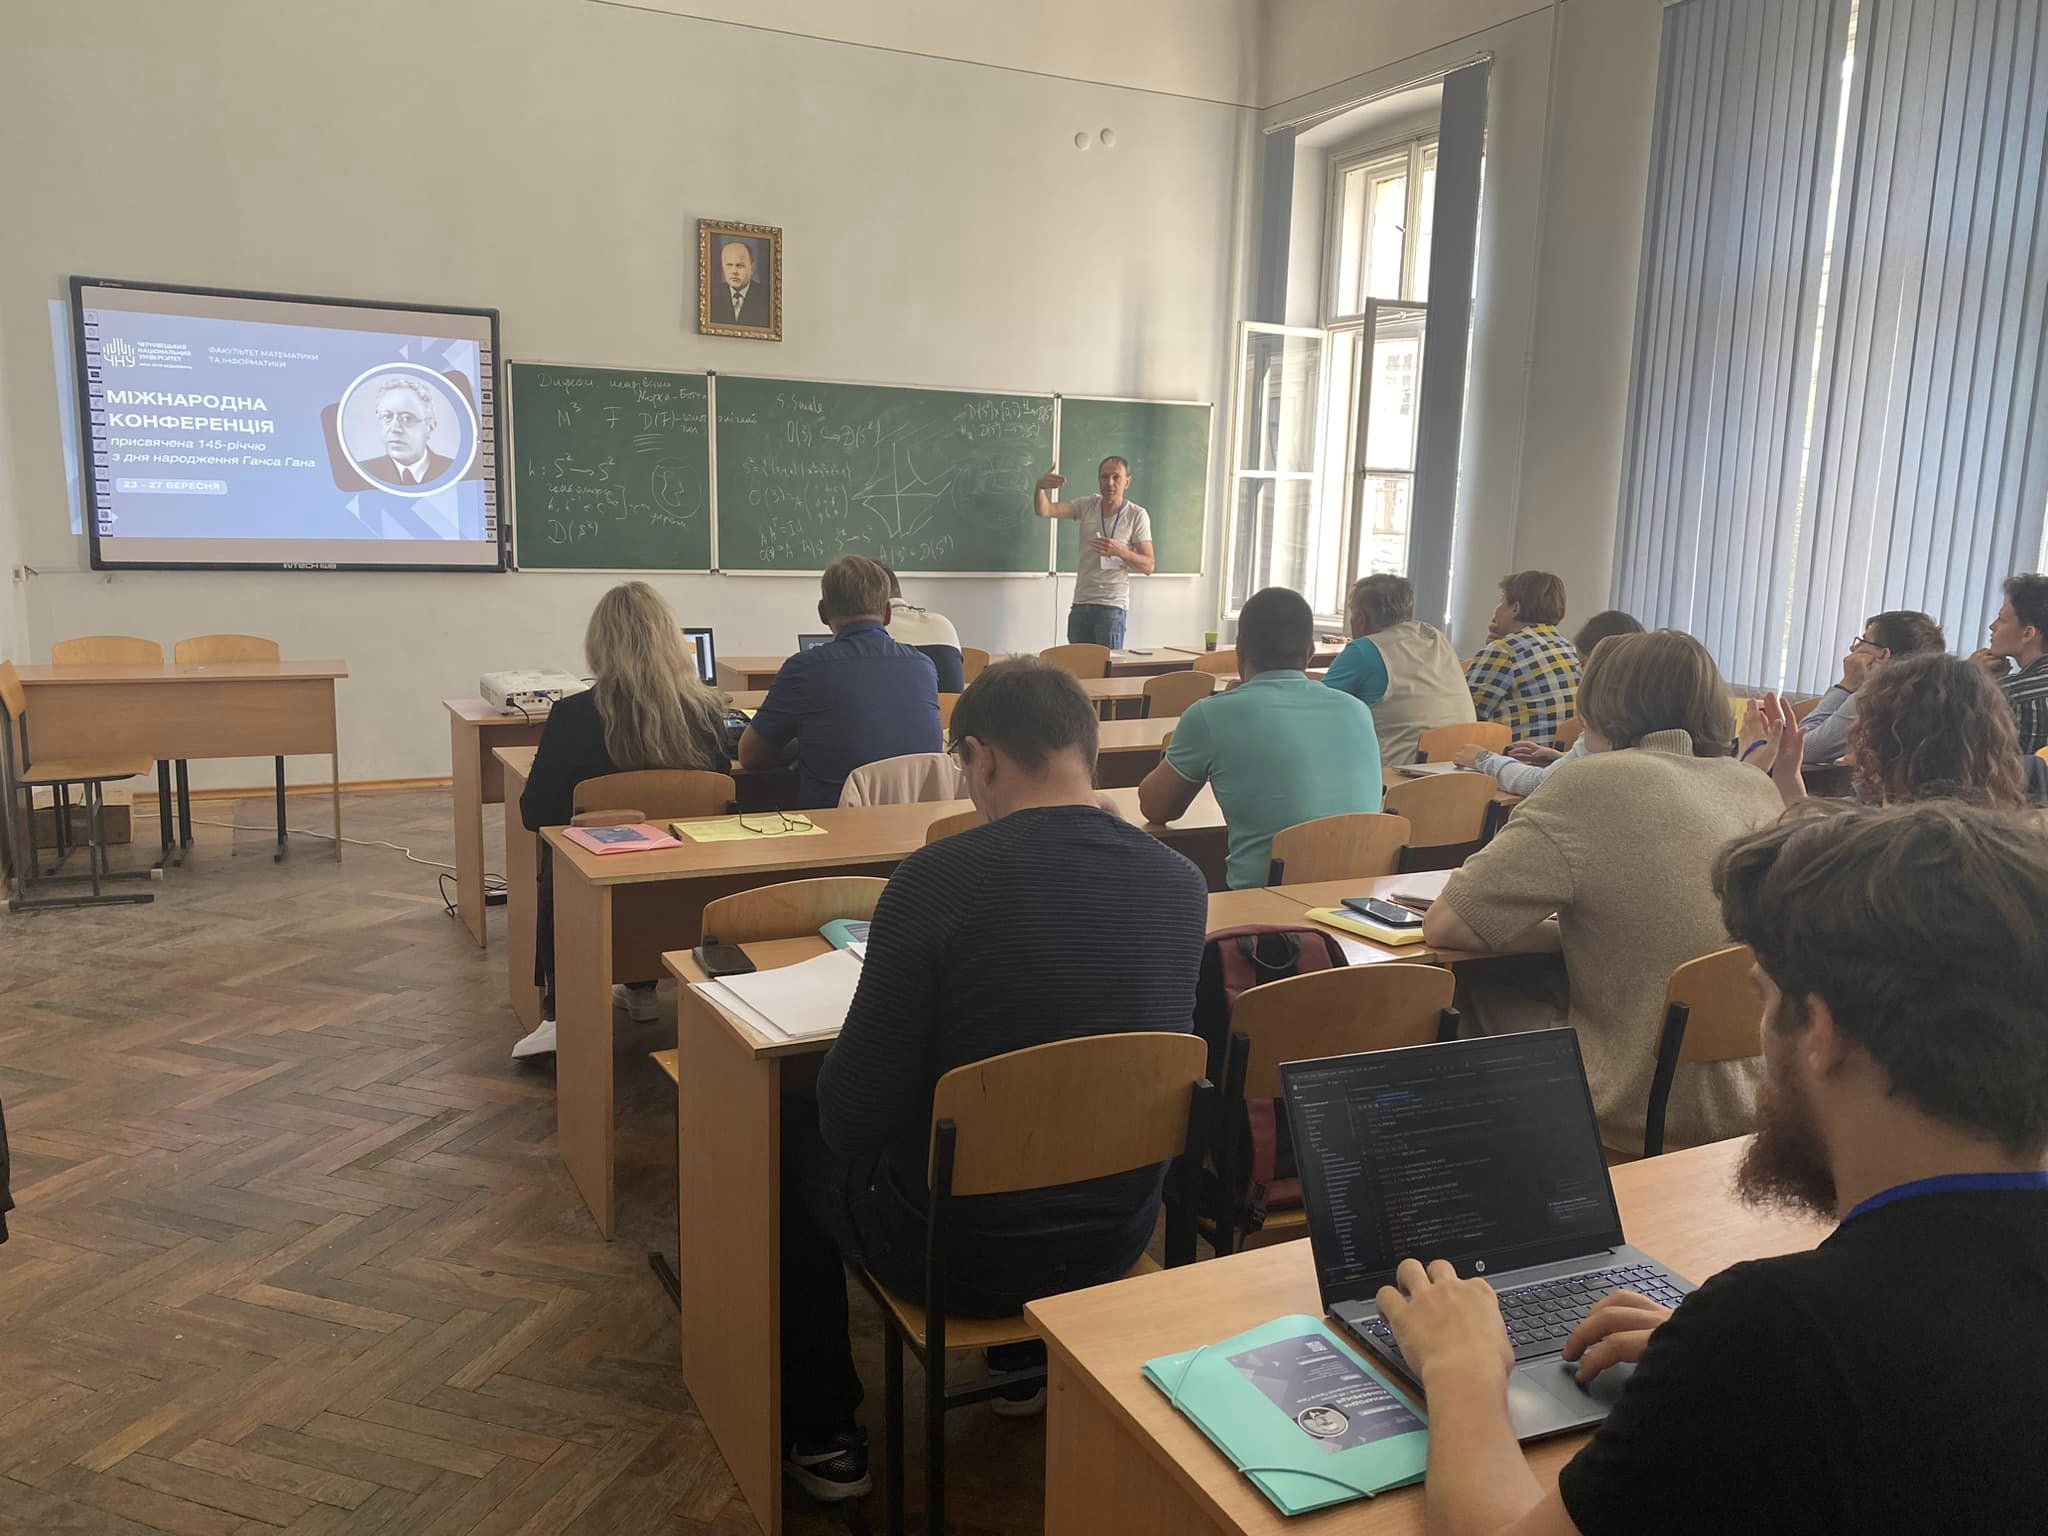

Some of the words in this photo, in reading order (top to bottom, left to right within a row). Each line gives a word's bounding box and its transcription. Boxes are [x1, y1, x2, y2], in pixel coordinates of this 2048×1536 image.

[208, 346, 259, 356] ФАКУЛЬТЕТ
[260, 350, 319, 361] МАТЕМАТИКИ
[208, 356, 220, 364] ТА
[222, 357, 287, 368] ІНФОРМАТИКИ
[106, 389, 267, 412] МІЖНАРОДНА
[108, 413, 274, 435] КОНФЕРЕНЦІЯ
[111, 438, 194, 449] присвячена
[199, 439, 266, 452] 145-річчю
[112, 453, 120, 462] з
[123, 453, 150, 464] дня
[153, 453, 239, 466] народження
[165, 480, 221, 491] ВЕРЕСНЯ
